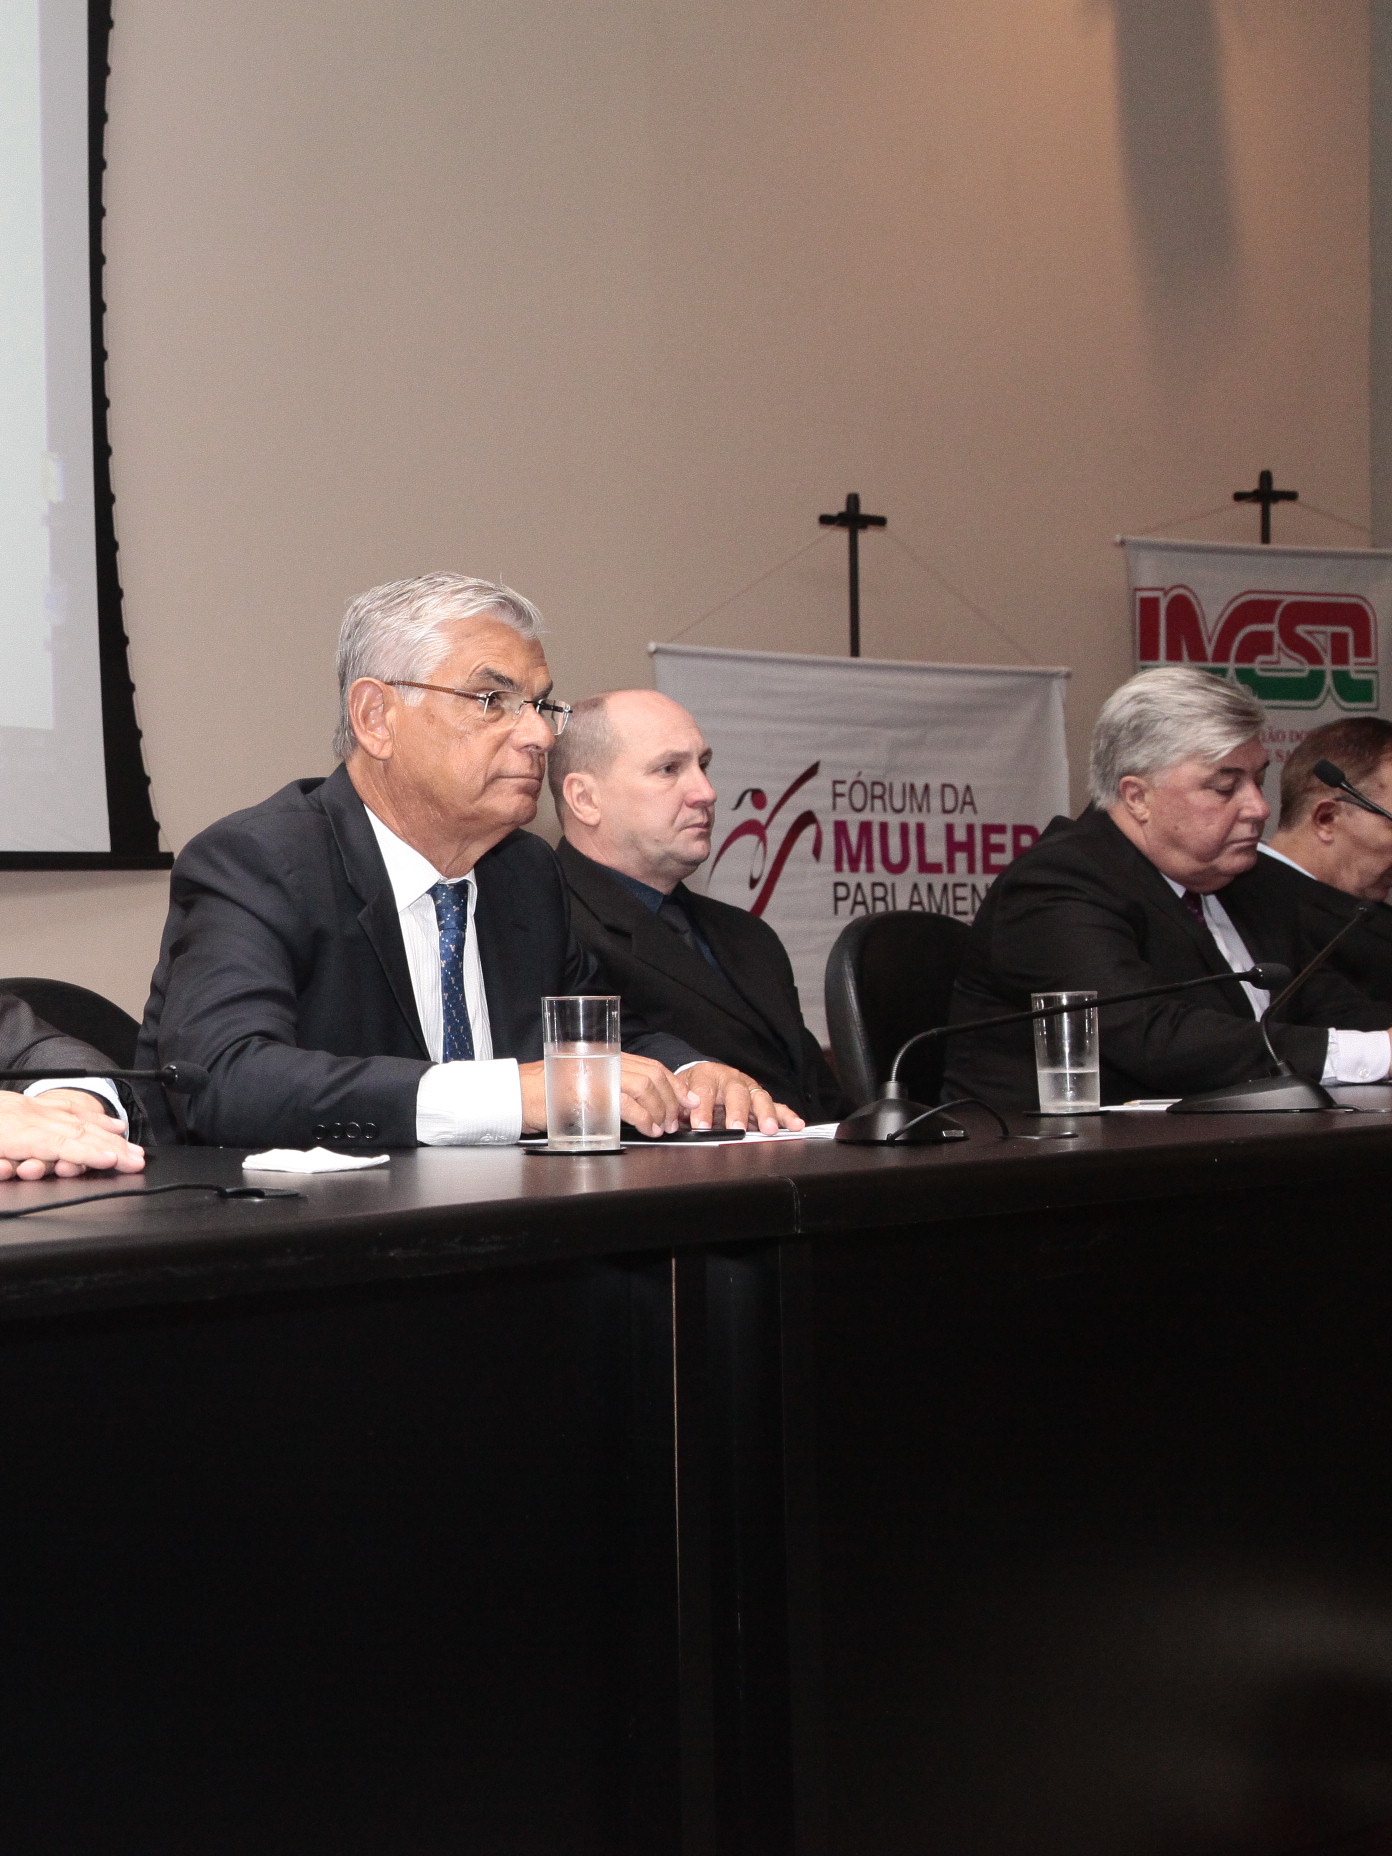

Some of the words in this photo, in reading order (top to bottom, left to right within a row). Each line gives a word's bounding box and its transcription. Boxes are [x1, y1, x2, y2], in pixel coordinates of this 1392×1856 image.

[832, 770, 931, 814] FÓRUM
[941, 783, 978, 815] DA
[833, 881, 991, 916] PARLAMEN
